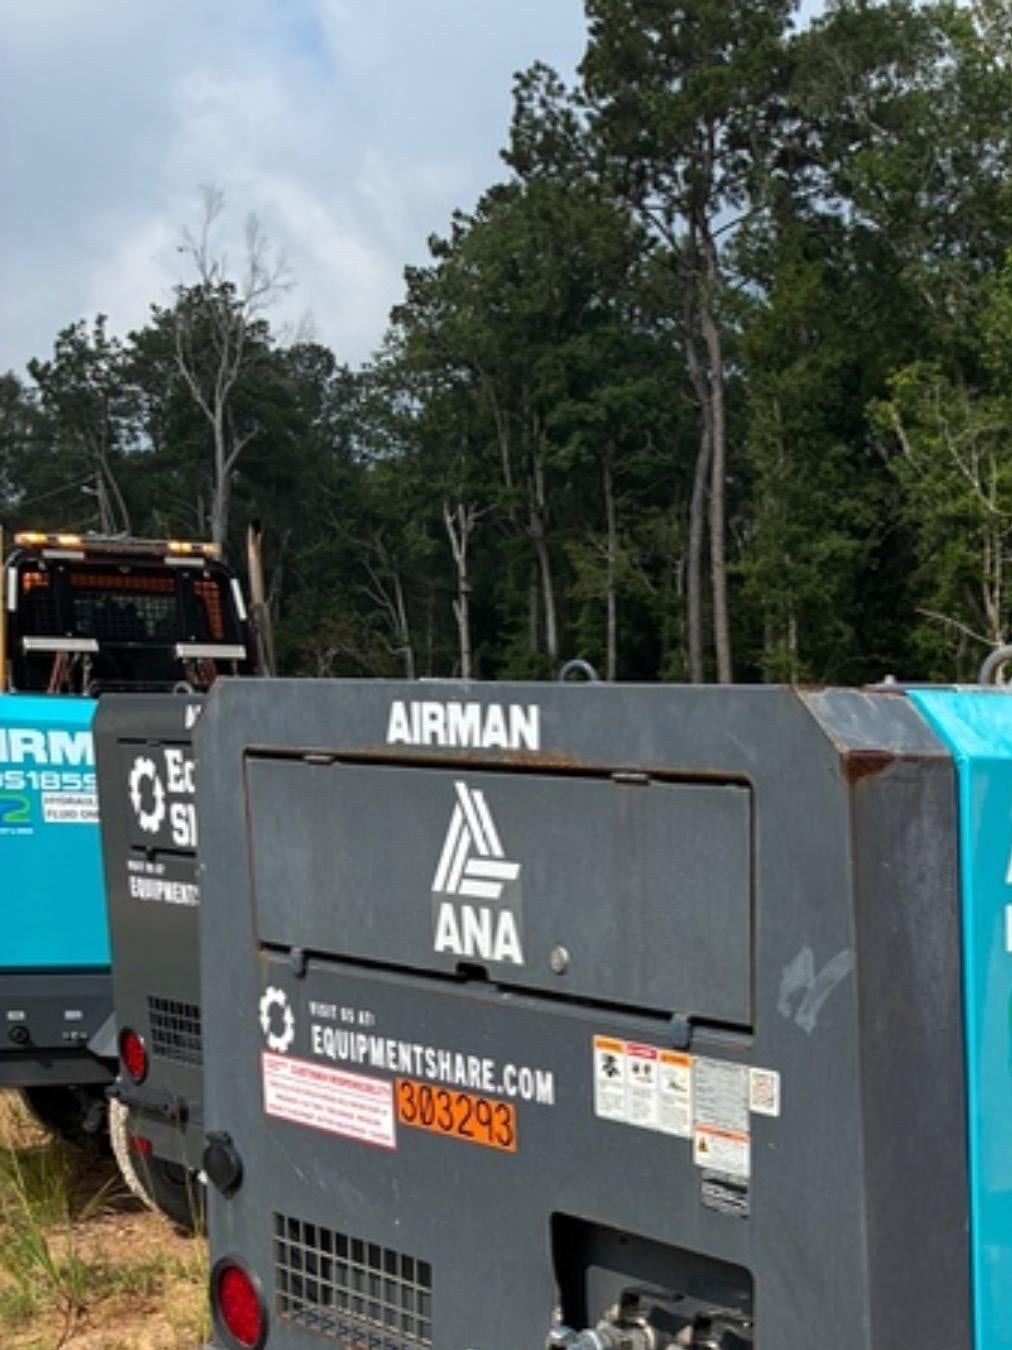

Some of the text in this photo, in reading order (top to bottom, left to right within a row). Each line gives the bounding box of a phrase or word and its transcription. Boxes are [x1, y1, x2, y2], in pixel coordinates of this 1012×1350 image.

[387, 701, 540, 750] AIRMAN
[434, 902, 525, 965] ANA
[311, 1025, 556, 1105] EQUIPMENTSHARE.COM
[400, 1081, 515, 1148] 303293
